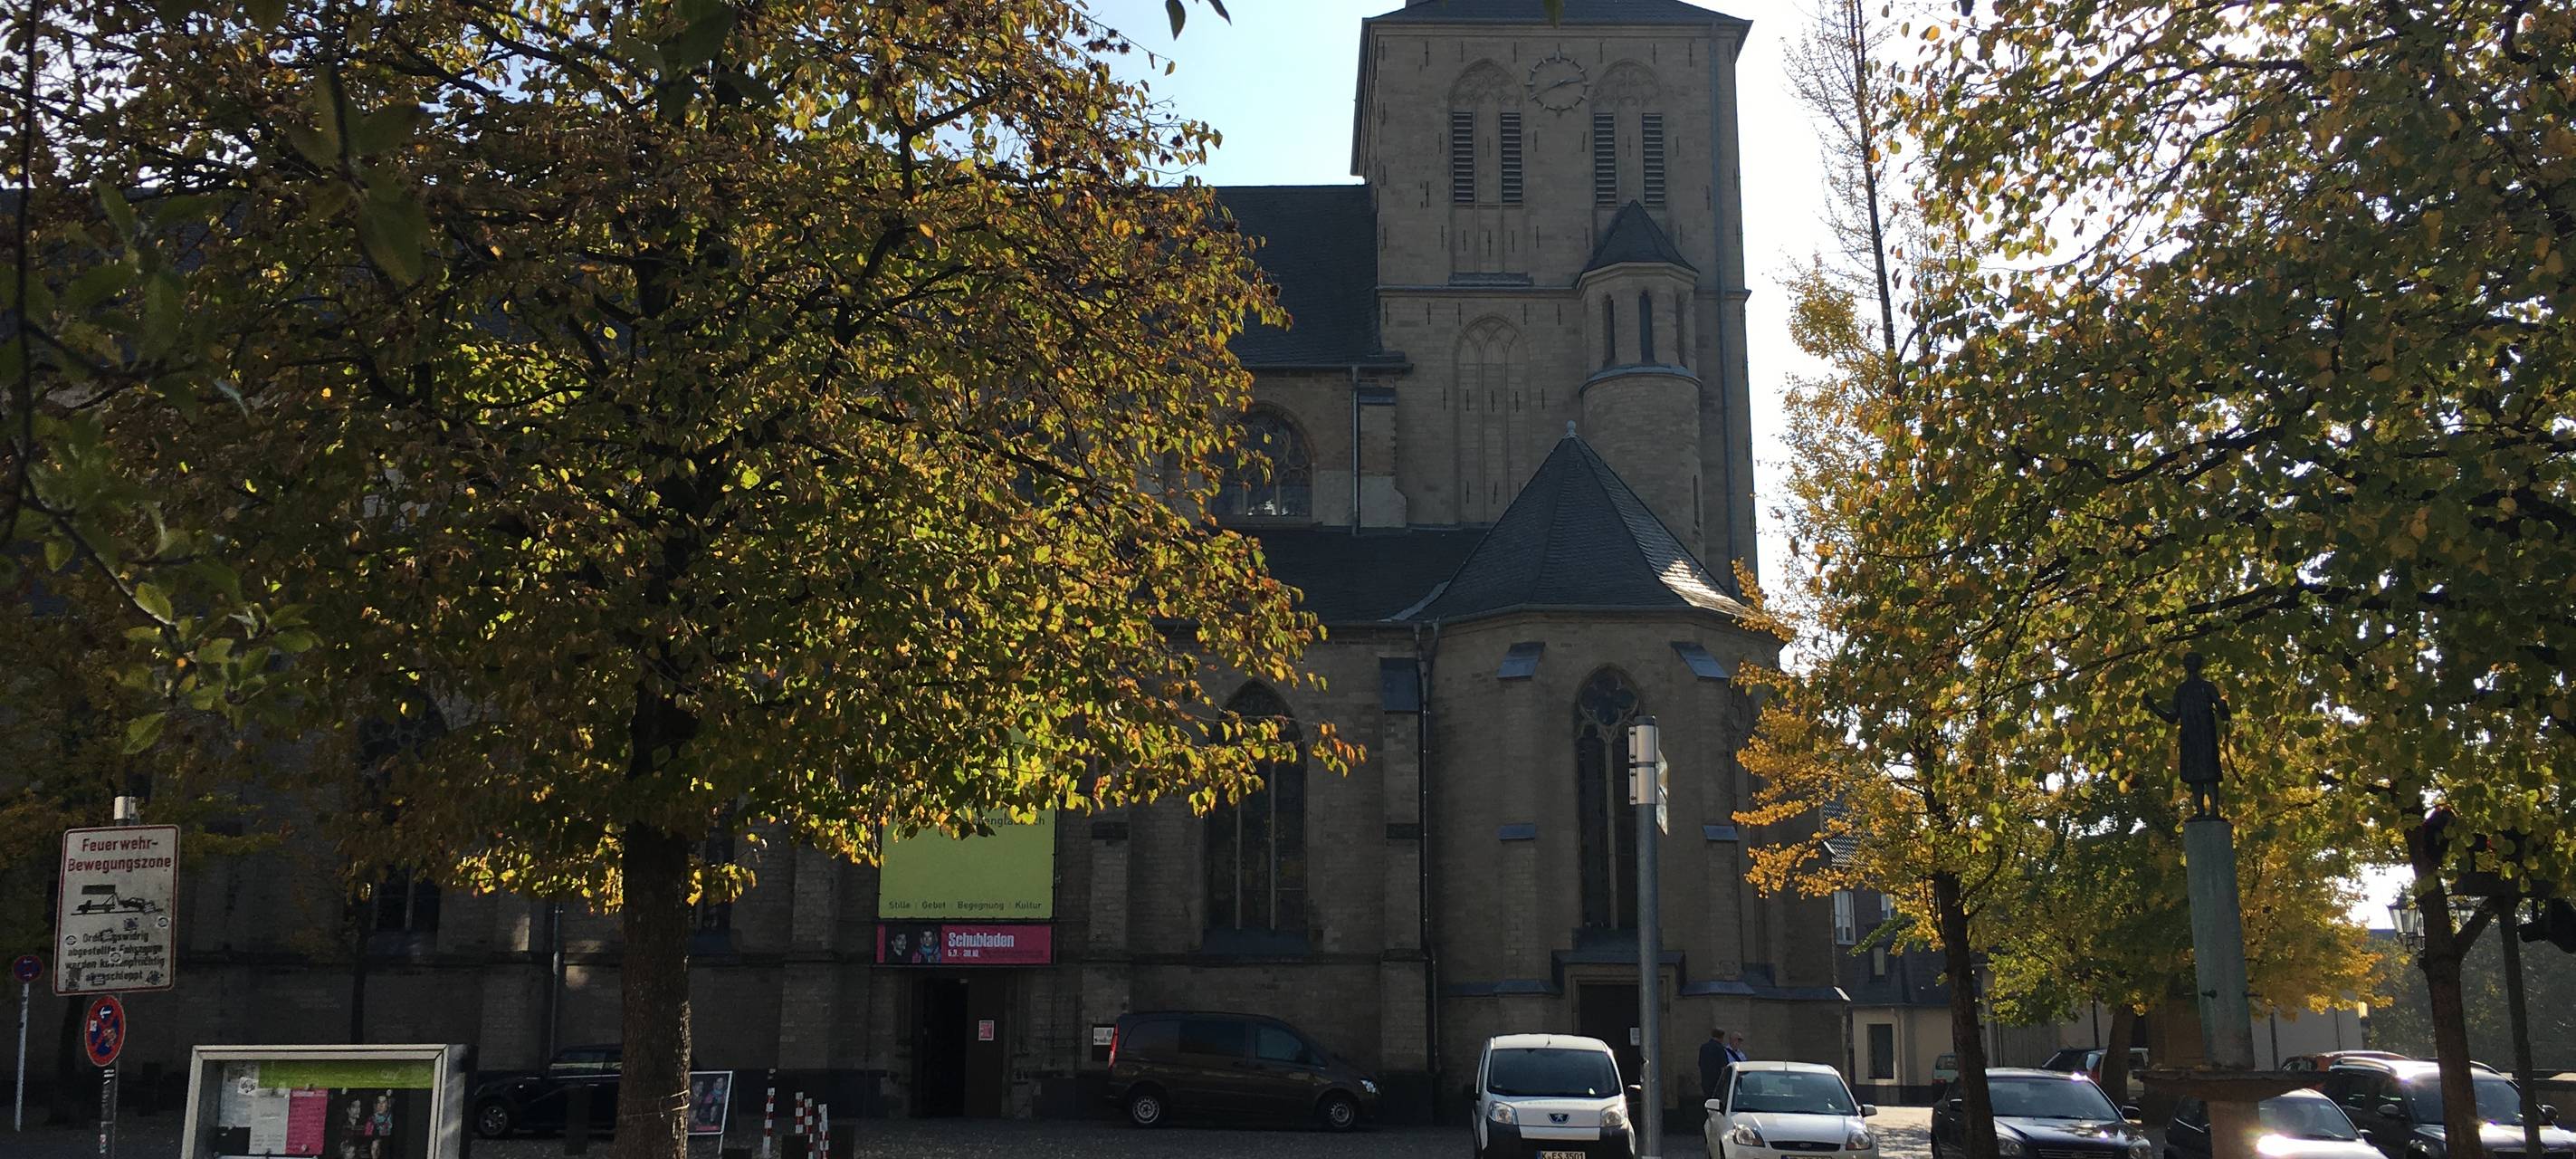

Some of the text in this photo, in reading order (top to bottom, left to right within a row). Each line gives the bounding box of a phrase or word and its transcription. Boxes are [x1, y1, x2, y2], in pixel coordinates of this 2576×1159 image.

[81, 837, 158, 852] Feuerwehr-
[68, 857, 171, 873] Bewegungszone
[889, 900, 1043, 911] Stille Gebet Begegnung Kultur
[948, 932, 1015, 948] Schubladen
